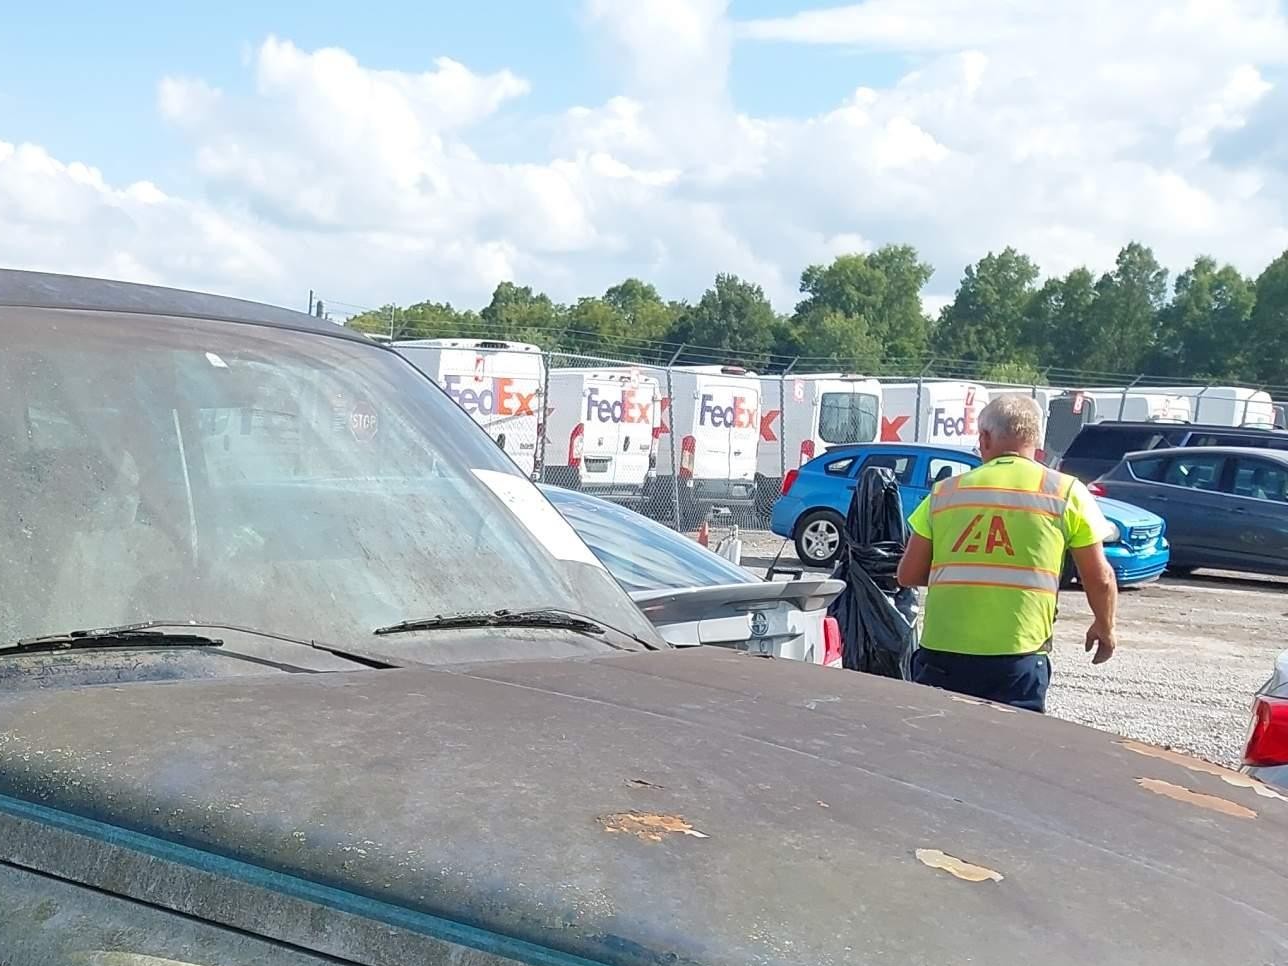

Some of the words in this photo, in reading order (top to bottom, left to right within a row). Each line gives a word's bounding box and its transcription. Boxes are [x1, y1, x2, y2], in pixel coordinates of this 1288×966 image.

[444, 374, 535, 416] FedEx
[586, 387, 650, 424] FedEx
[699, 393, 757, 428] FedEx
[352, 414, 376, 429] STOP
[933, 407, 978, 436] FedE
